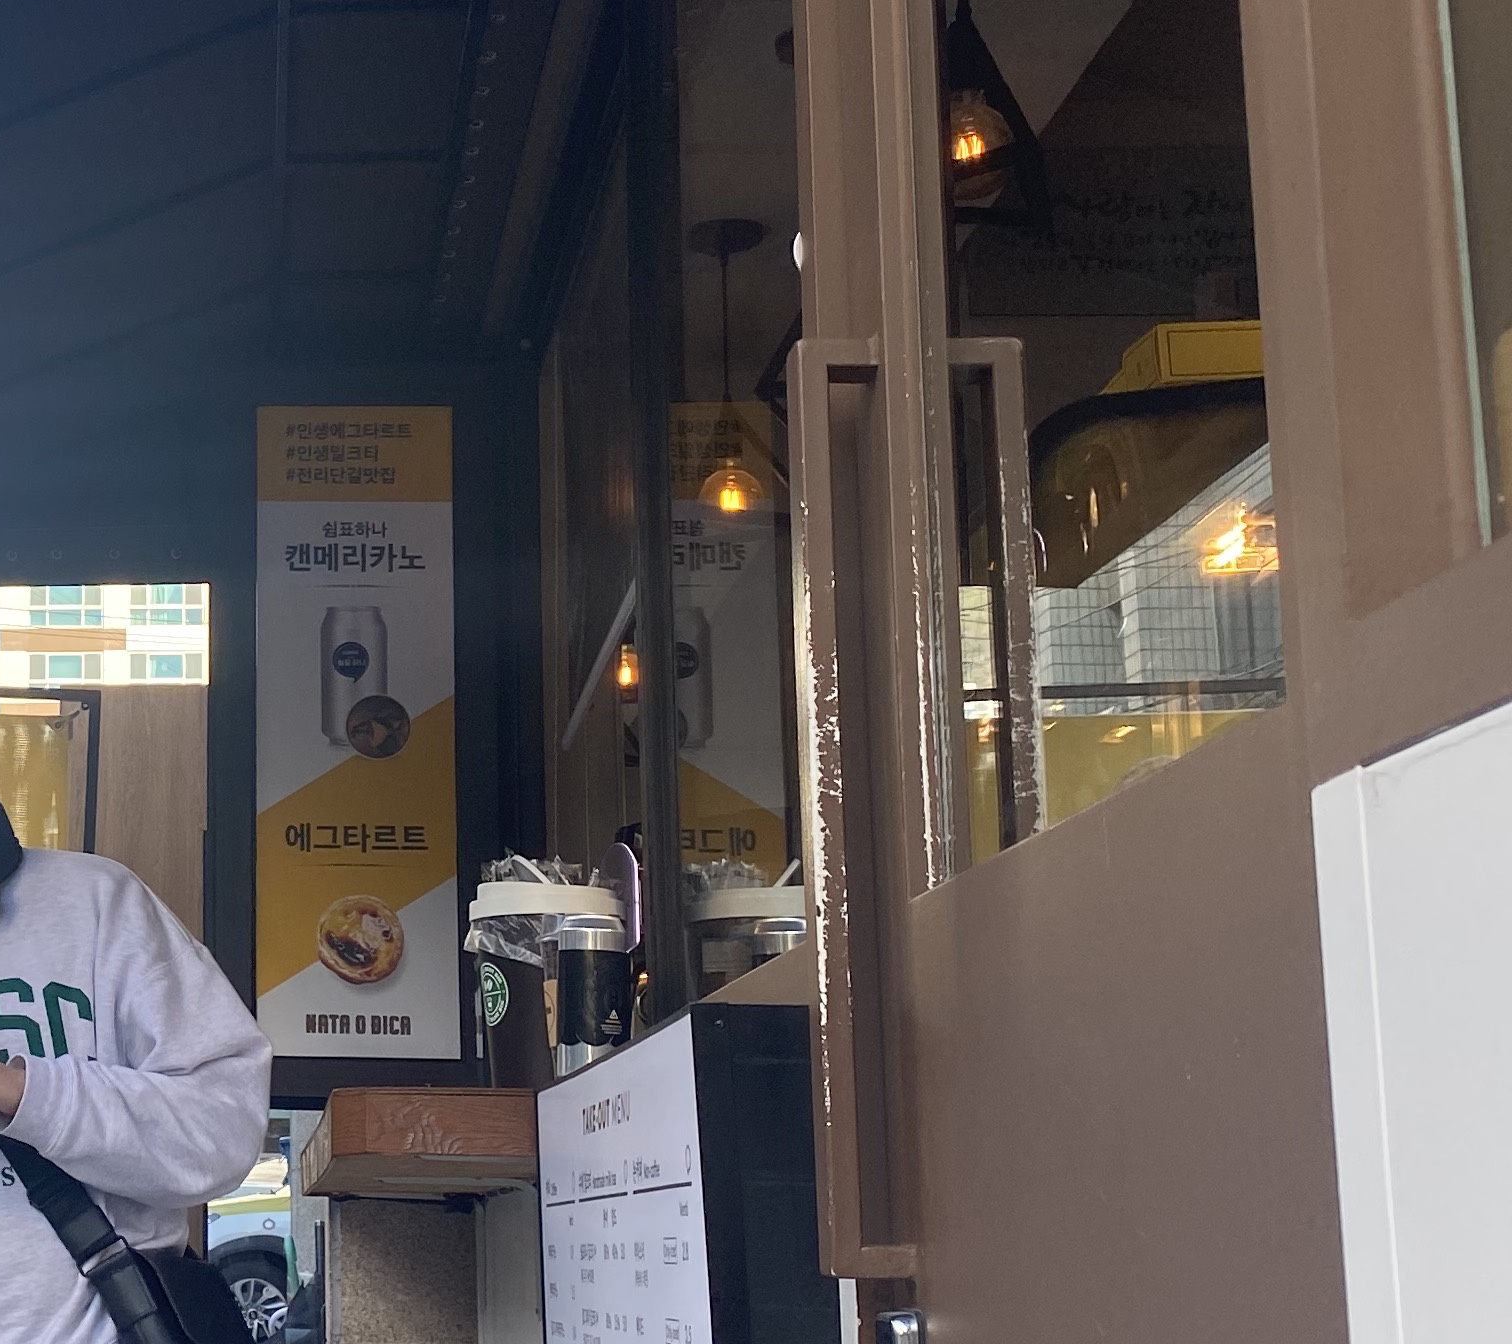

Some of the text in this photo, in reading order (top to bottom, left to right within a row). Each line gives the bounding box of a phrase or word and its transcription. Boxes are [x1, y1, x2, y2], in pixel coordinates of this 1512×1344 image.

[286, 422, 413, 440] #인생에그타르트
[286, 445, 379, 462] #인생밀크티
[286, 467, 396, 484] #전리단길맛집
[322, 521, 388, 539] 쉼표하나
[285, 543, 426, 573] 캔메리카노
[285, 822, 429, 853] 에그타르트
[305, 1013, 411, 1035] NATA O BICA
[611, 1090, 631, 1127] MENU
